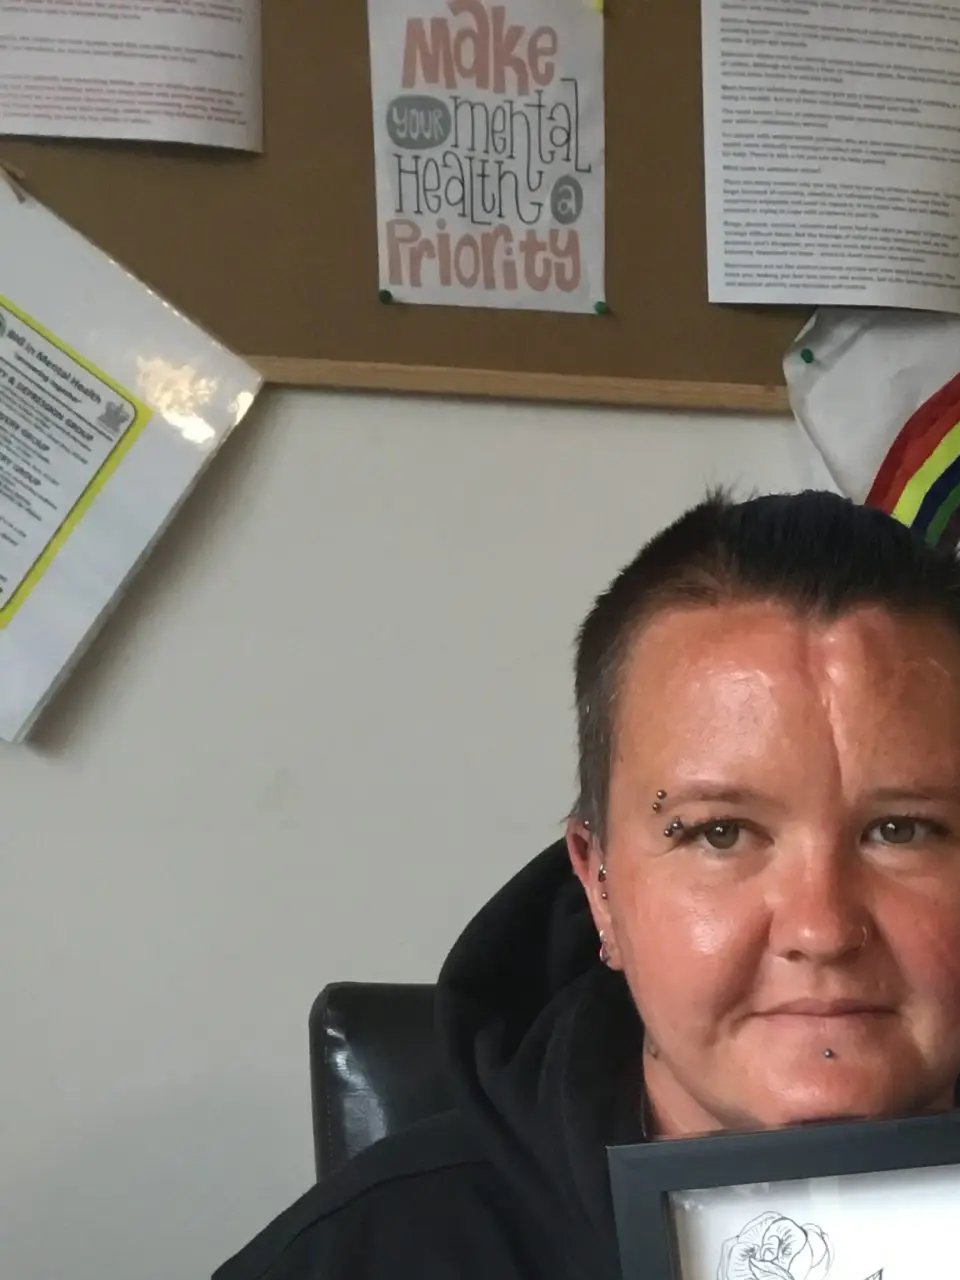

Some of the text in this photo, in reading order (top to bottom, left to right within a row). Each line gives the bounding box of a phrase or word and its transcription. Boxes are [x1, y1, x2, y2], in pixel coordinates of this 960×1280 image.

[402, 0, 558, 96] Make
[449, 78, 591, 192] mental
[386, 217, 582, 293] Priority
